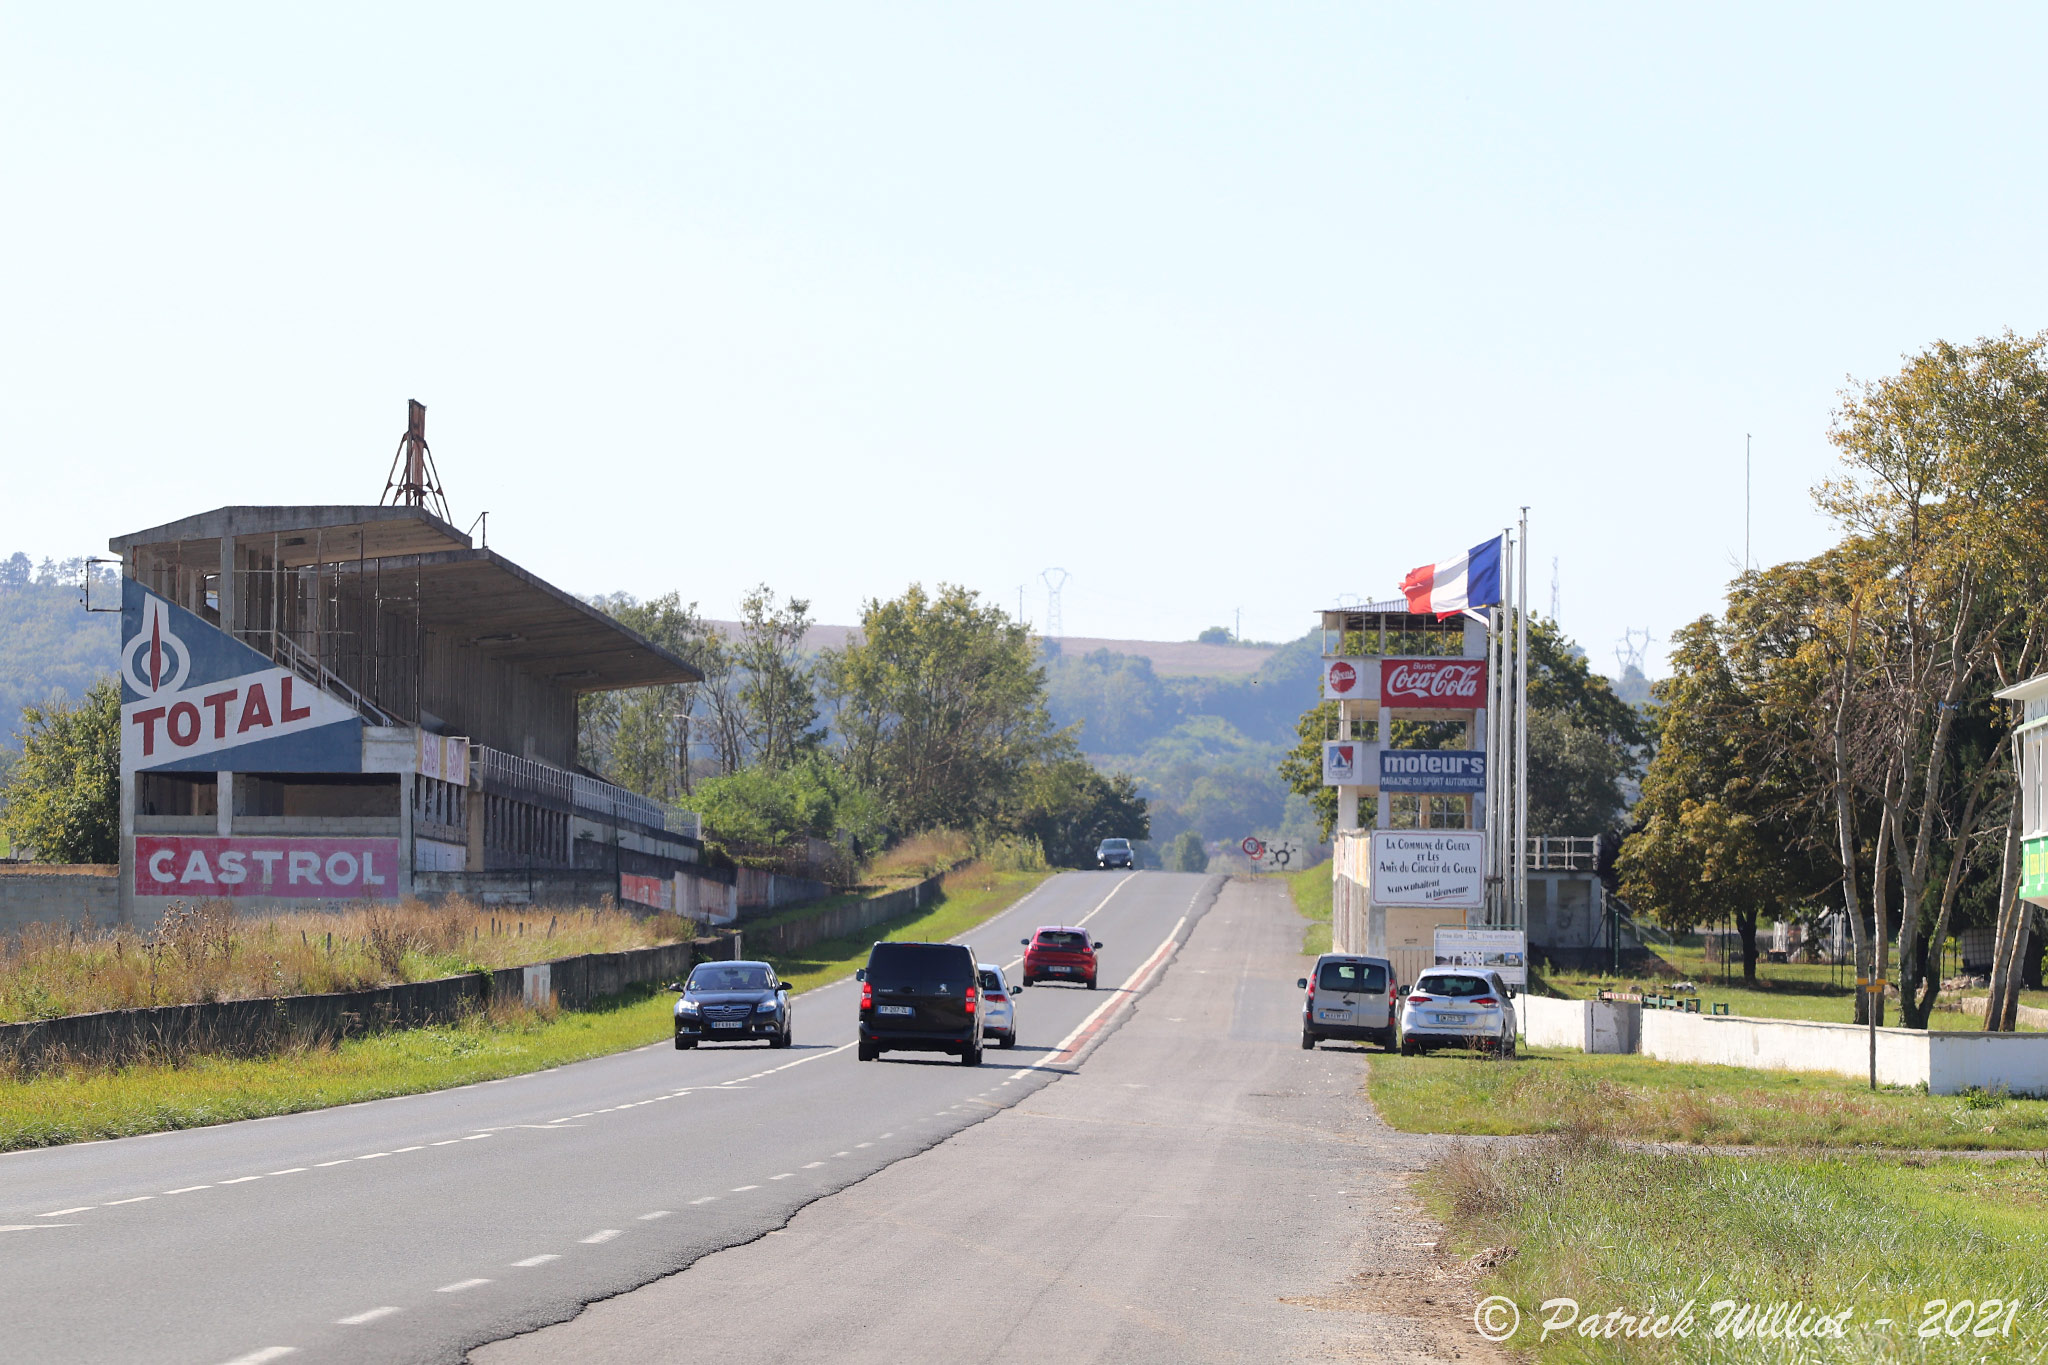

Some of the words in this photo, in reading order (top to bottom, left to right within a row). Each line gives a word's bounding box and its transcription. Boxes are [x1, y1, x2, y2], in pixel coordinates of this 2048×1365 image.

[1387, 665, 1481, 698] Coca-Cola
[132, 676, 311, 756] TOTAL
[1384, 754, 1484, 773] moteurs
[1381, 777, 1412, 785] MAGAZINE
[1413, 777, 1422, 785] DU
[1423, 777, 1444, 786] SPORT
[1445, 777, 1484, 786] AUTOMOBILE
[149, 850, 385, 885] CASTROL
[1433, 886, 1469, 898] bienvenue
